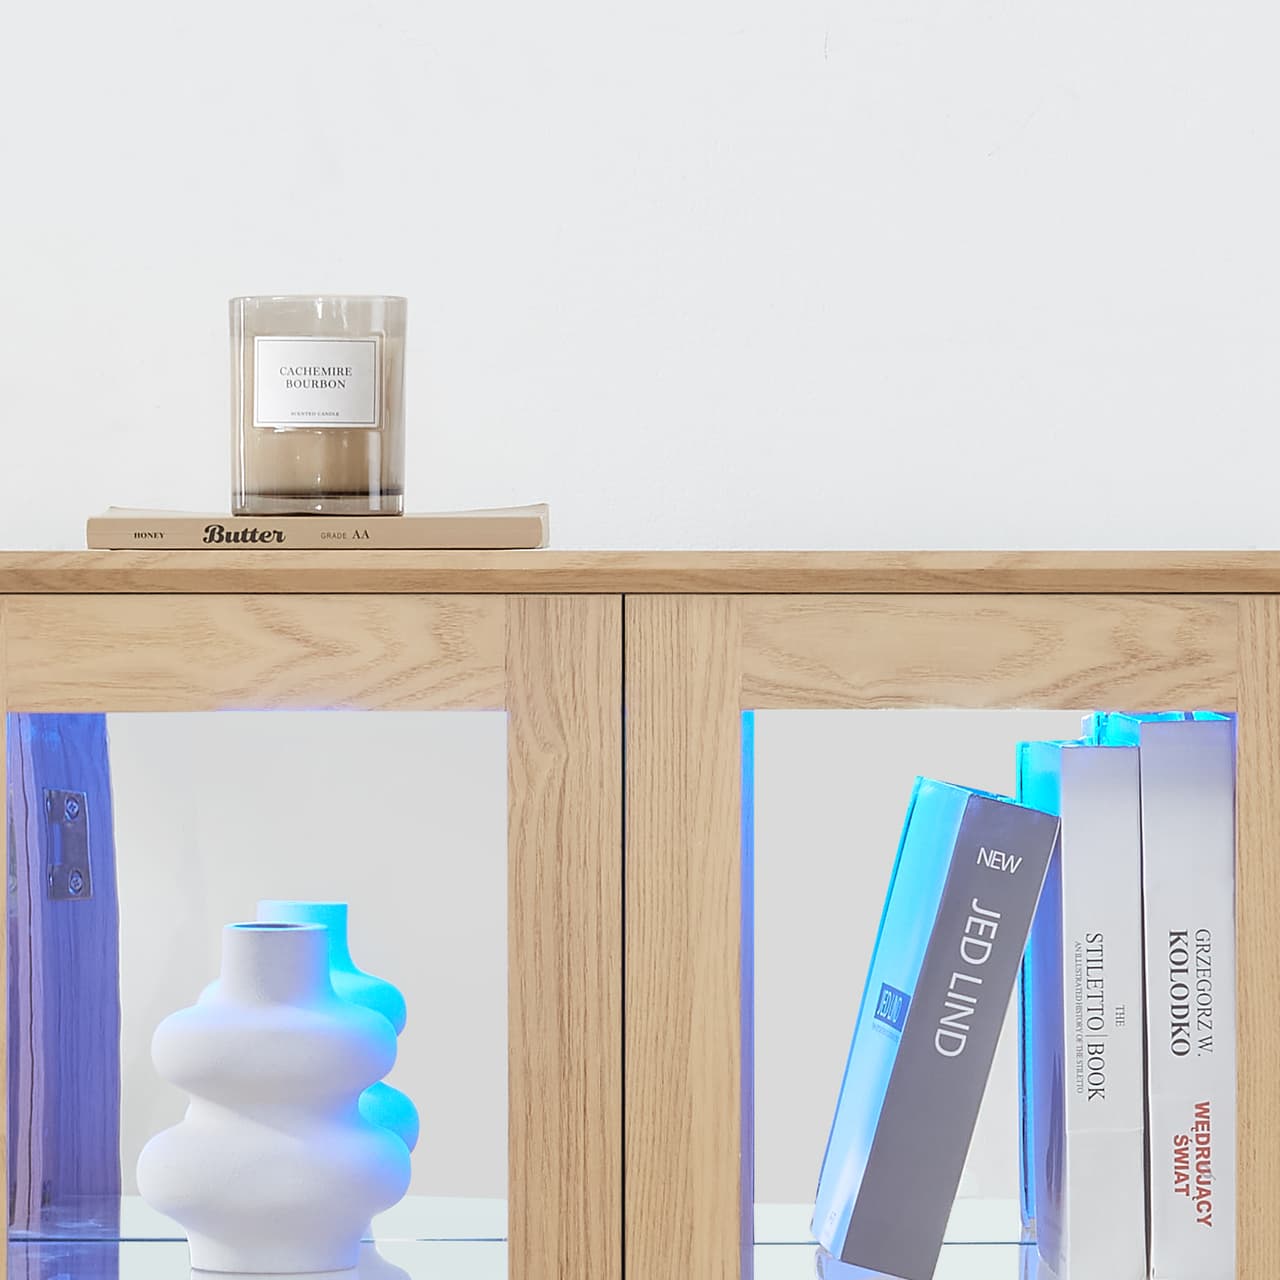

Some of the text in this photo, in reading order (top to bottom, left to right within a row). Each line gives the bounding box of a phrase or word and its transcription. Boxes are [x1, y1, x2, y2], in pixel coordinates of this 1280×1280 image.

[279, 366, 353, 377] CACHEMIRE
[285, 379, 346, 389] BOURBON
[133, 524, 370, 544] HONEY Butter GRADE AA
[976, 847, 1022, 874] NEW
[934, 897, 1001, 1058] JED LIND
[1169, 930, 1192, 1057] KOLODKO
[1194, 928, 1214, 1057] GRZEGORZ W.
[1085, 932, 1106, 1102] STILETTO BOOK
[1115, 1004, 1126, 1027] THE
[1173, 1134, 1193, 1197] ŚWIAT
[1191, 1101, 1213, 1227] WĘDRUJĄCY
